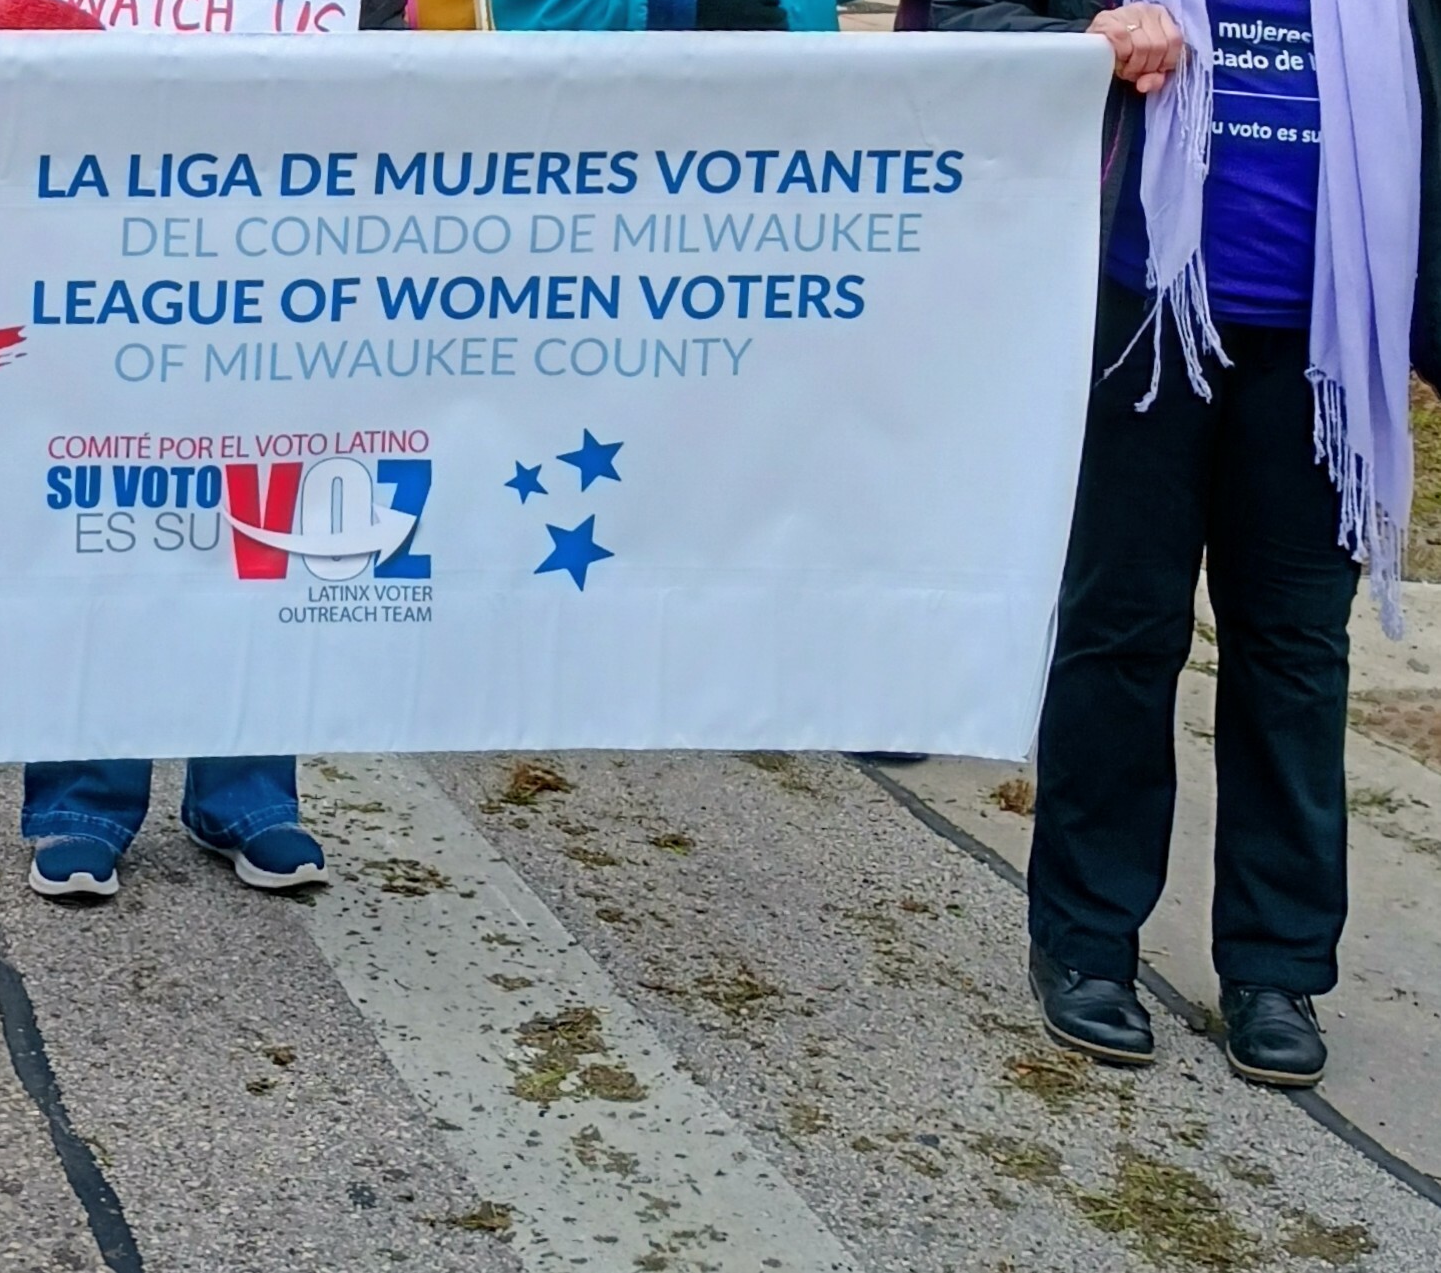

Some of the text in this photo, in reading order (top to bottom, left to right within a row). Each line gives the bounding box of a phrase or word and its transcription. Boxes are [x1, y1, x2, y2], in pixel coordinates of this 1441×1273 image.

[1275, 50, 1305, 71] de
[1228, 121, 1272, 140] voto
[1277, 125, 1297, 142] es
[38, 150, 964, 198] LA LIGA DE MUJERES VOTANTES
[122, 212, 922, 258] DEL CONDADO DE MILWAUKEE
[32, 274, 866, 326] LEAGUE OF WOMEN VOTERS
[114, 337, 753, 383] OF MILWAUKEE COUNTY
[48, 430, 430, 460] COMITÉ POR EL VOTO LATINO
[46, 465, 223, 510] SU VOTO
[76, 511, 221, 554] ES SU
[225, 456, 433, 582] VOZ
[279, 606, 432, 623] OUTREACH TEAM
[308, 585, 433, 601] LATINX VOTER
